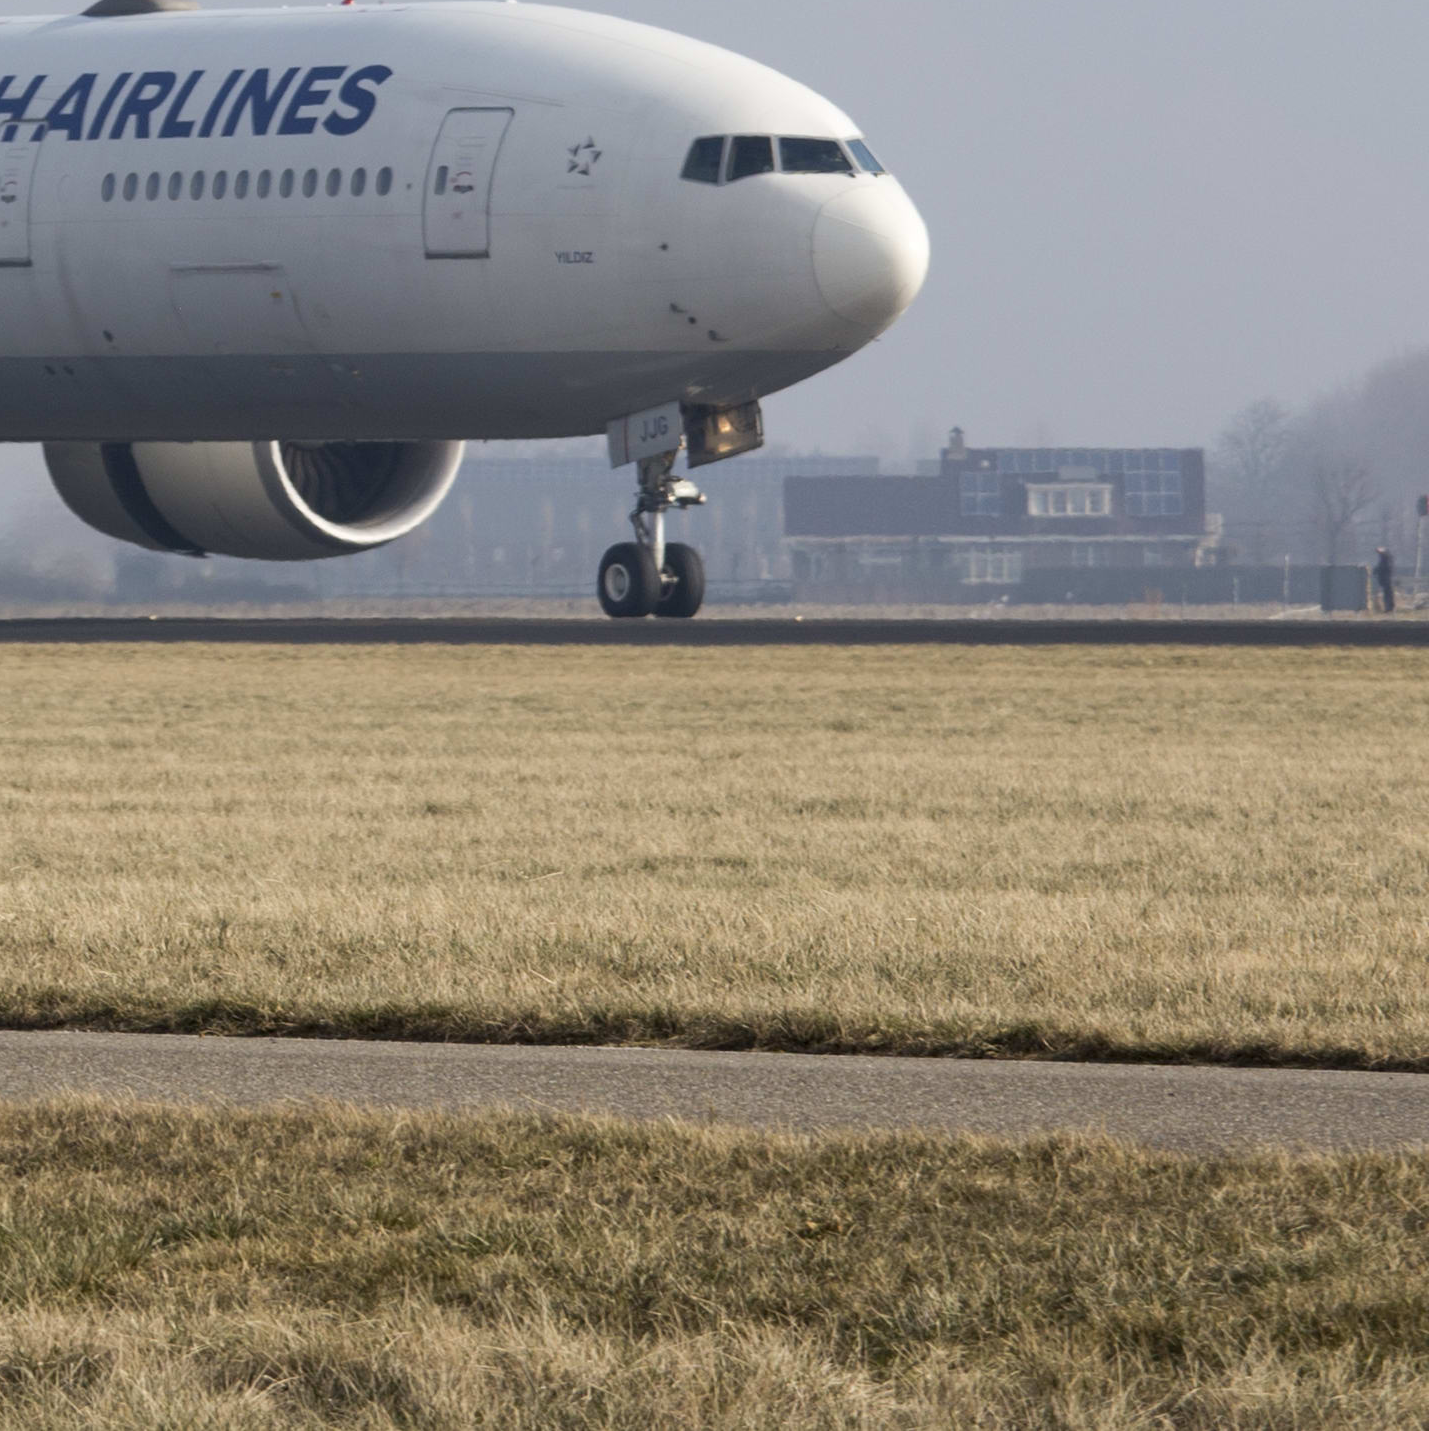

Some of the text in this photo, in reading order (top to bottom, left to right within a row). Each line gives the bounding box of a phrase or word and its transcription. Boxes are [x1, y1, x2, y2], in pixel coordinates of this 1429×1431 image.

[29, 64, 394, 141] AIRLINES
[554, 250, 594, 264] YILDIZ
[639, 415, 669, 442] JJG
